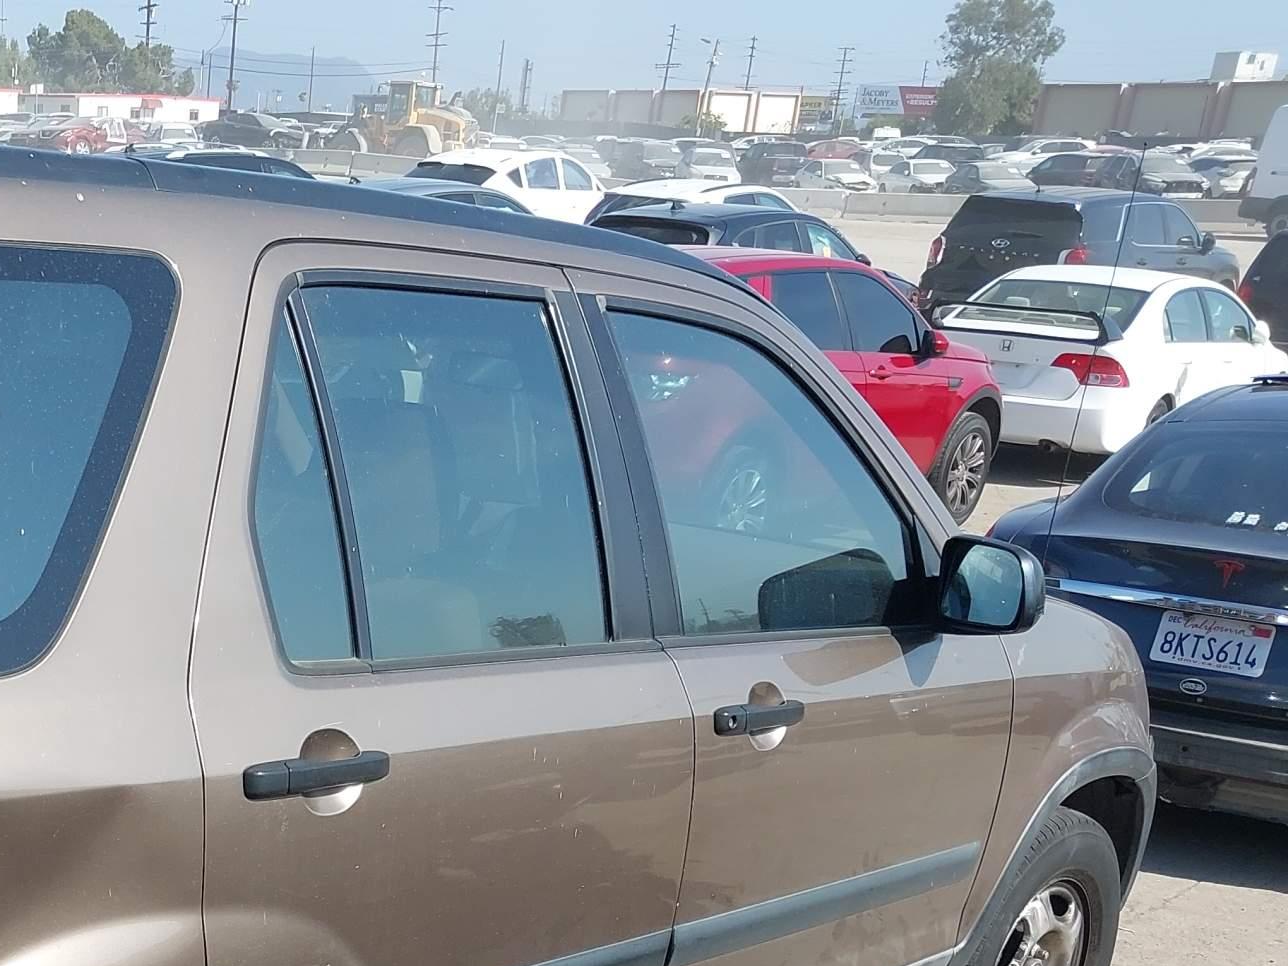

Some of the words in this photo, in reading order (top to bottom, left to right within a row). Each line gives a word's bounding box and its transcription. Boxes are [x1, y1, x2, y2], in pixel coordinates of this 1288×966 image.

[1168, 614, 1183, 624] DEC
[1183, 617, 1253, 638] California
[1159, 630, 1258, 669] 8KTS614
